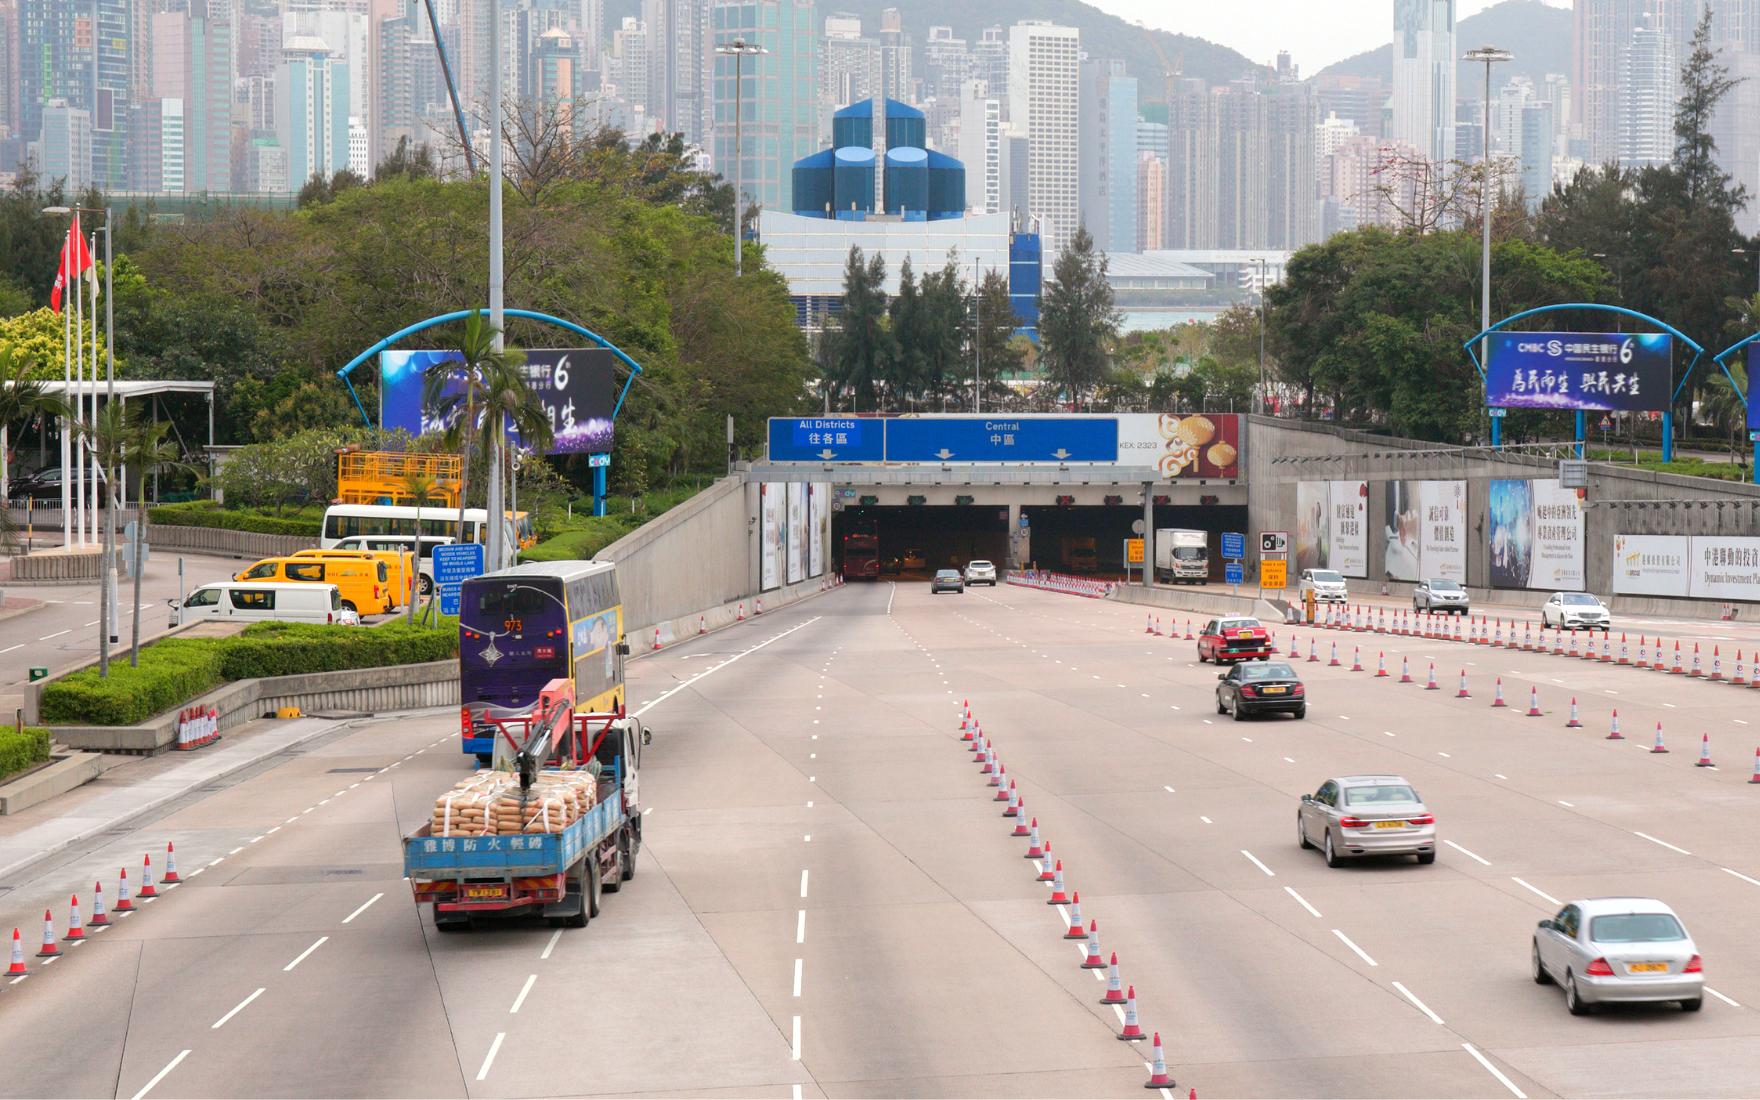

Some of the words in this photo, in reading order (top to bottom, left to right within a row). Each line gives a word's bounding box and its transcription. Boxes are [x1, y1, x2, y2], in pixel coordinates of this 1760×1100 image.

[799, 420, 813, 429] All
[815, 420, 855, 429] Districts
[985, 422, 1020, 431] Central
[808, 433, 848, 445] 往各區
[990, 433, 1015, 446] 中區
[1704, 571, 1724, 587] Dynamic
[1725, 571, 1752, 585] Investment
[503, 620, 523, 632] 973
